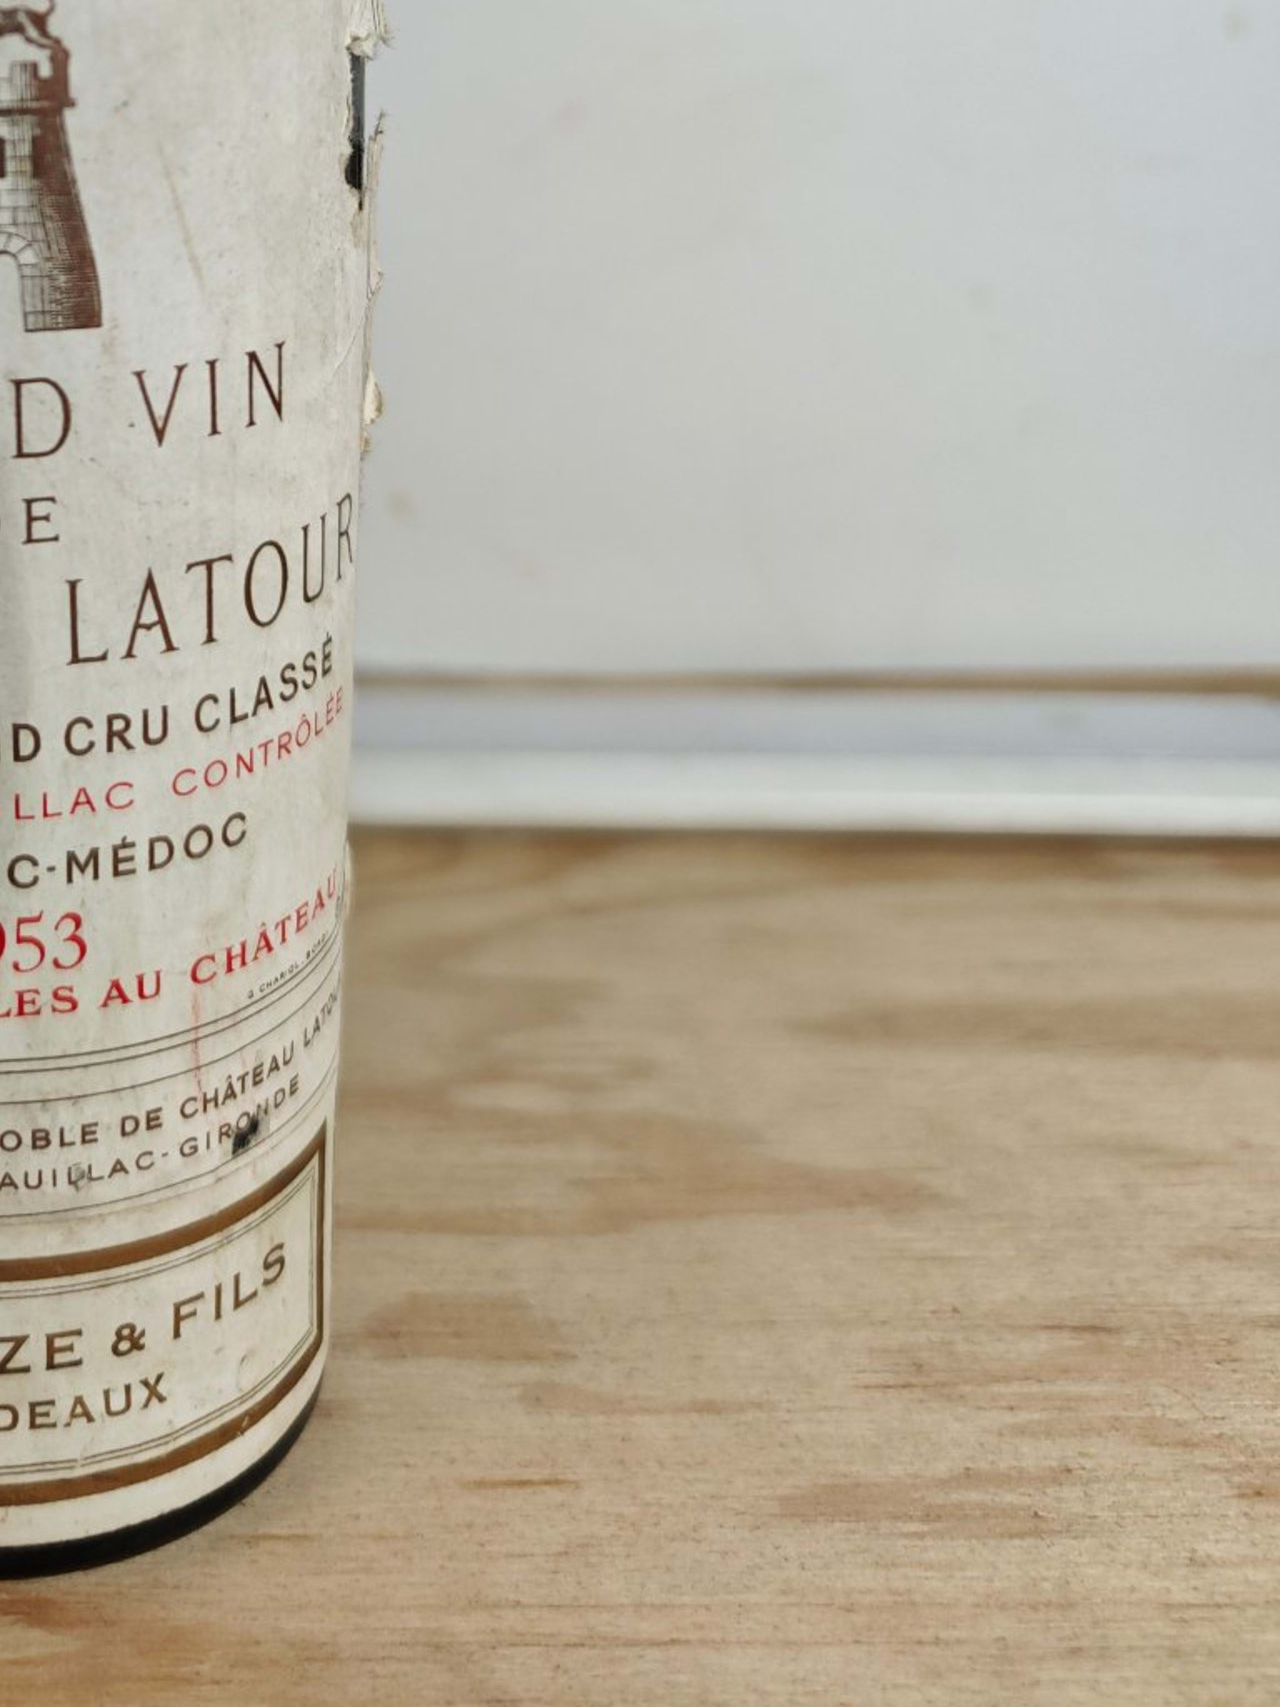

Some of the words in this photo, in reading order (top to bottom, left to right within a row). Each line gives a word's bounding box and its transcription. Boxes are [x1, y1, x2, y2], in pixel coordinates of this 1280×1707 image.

[132, 341, 286, 448] VIN
[66, 493, 354, 666] LATOUR
[64, 705, 169, 756] CRU
[194, 632, 333, 733] CLASSÉ
[172, 685, 344, 796] CONTRÔLÉE
[100, 970, 162, 1008] AU
[189, 870, 336, 986] CHÂTEAU
[120, 1106, 163, 1138] DE
[179, 1040, 294, 1121] CHÂTEAU
[303, 976, 340, 1048] LATOU
[110, 1321, 146, 1358] &
[171, 1241, 286, 1342] FILS
